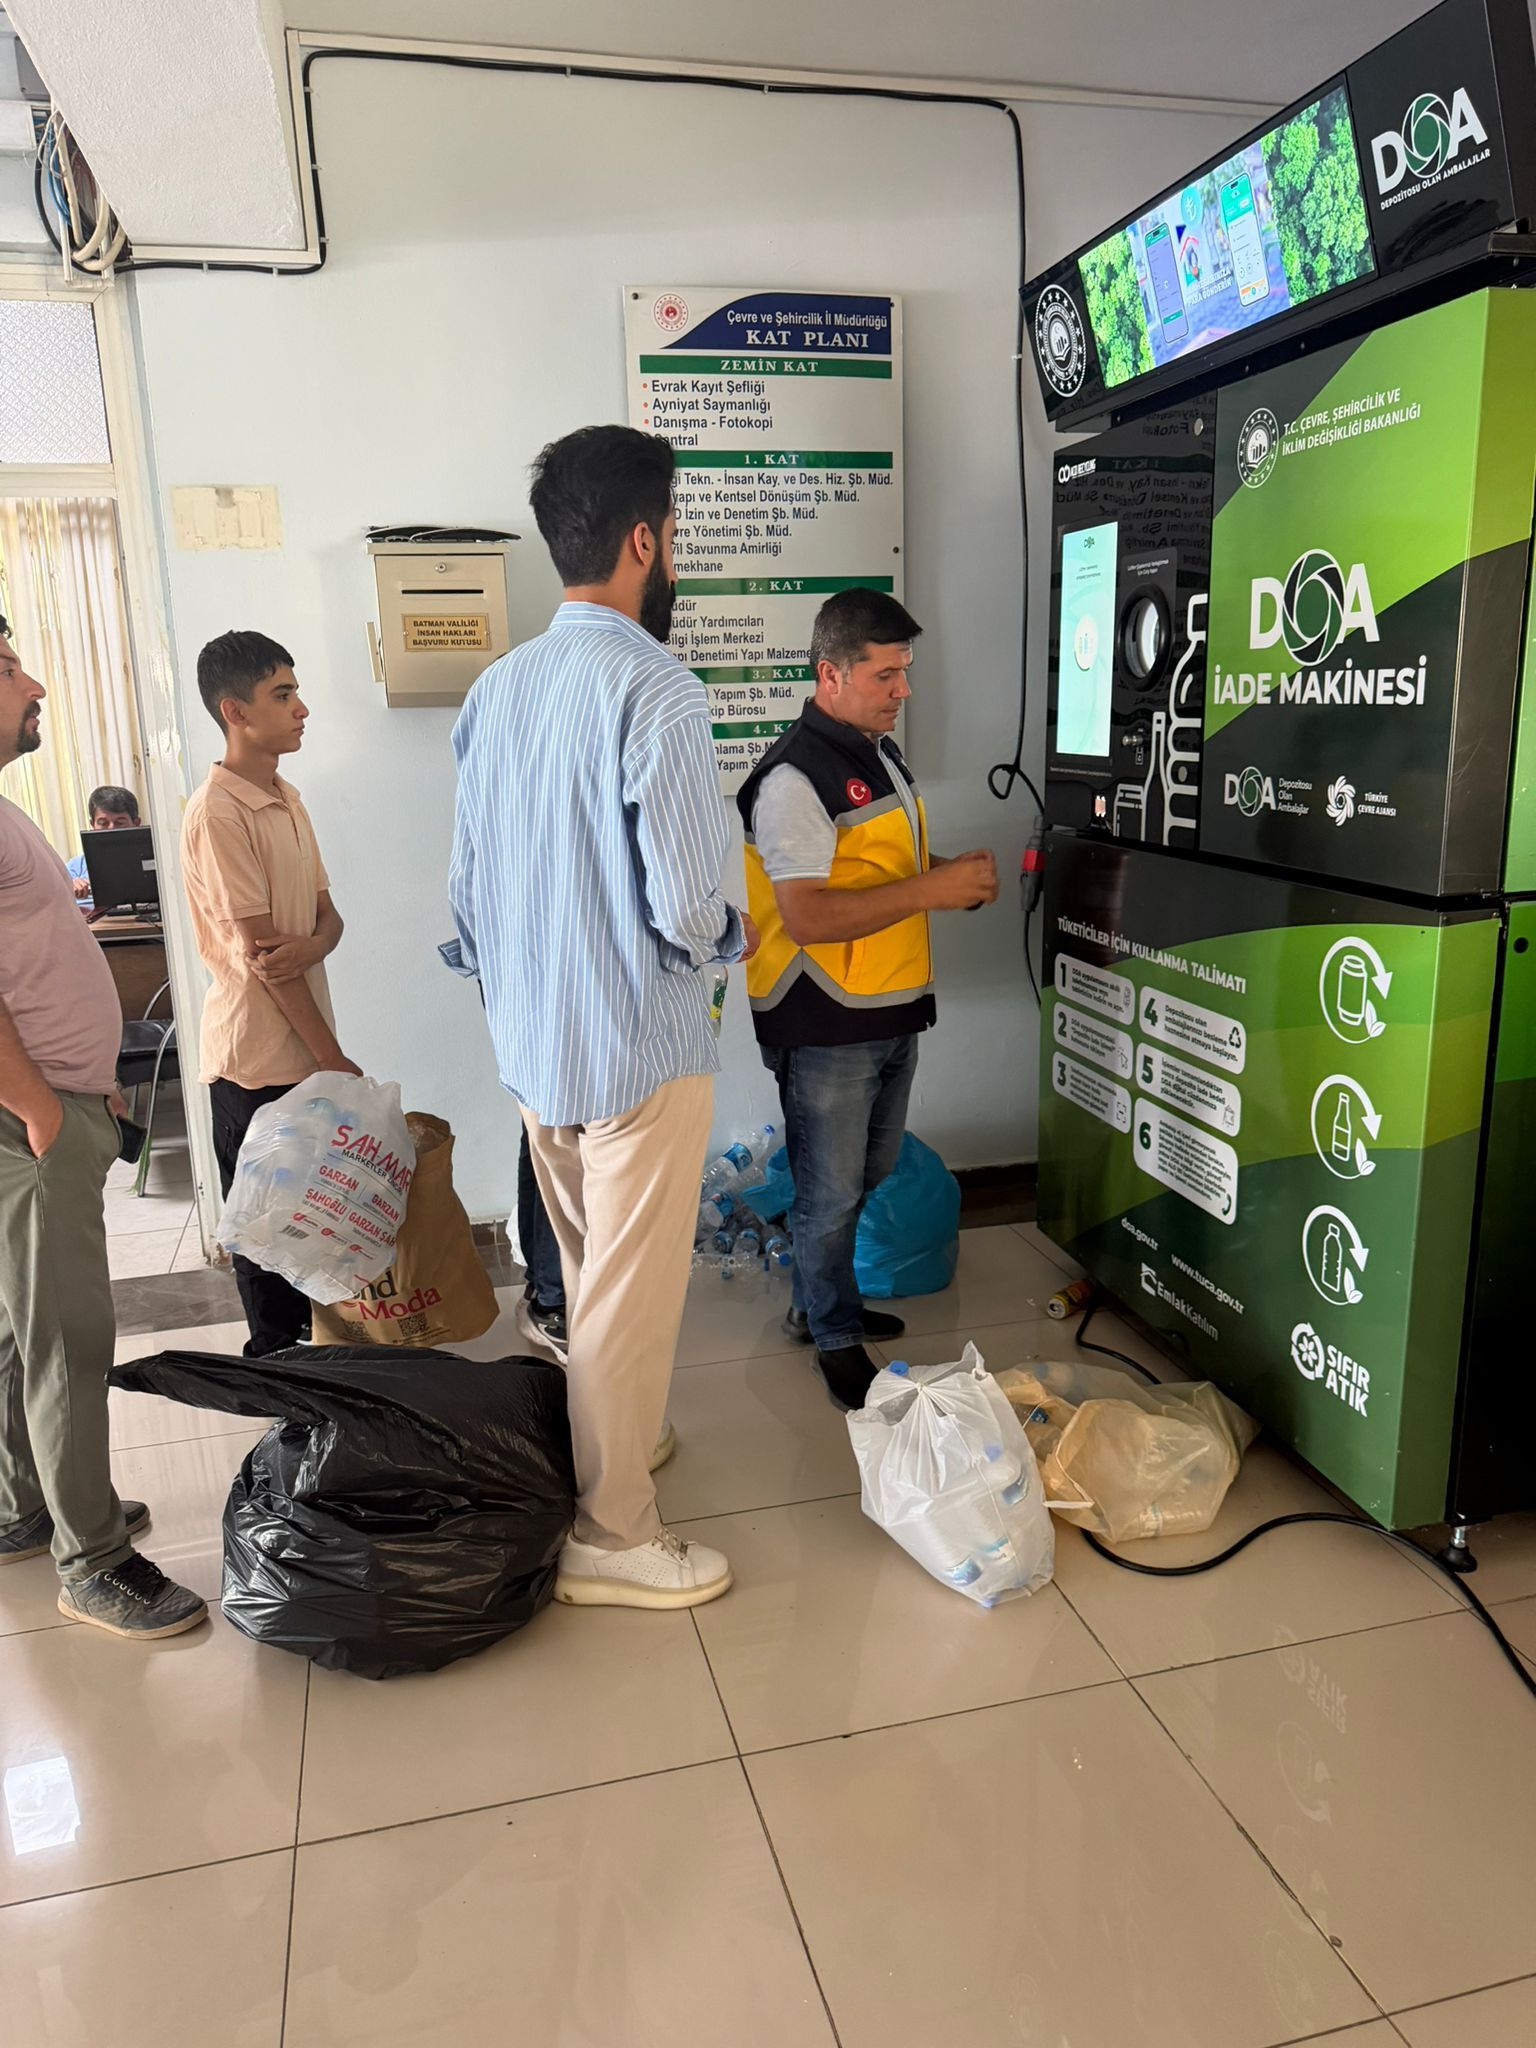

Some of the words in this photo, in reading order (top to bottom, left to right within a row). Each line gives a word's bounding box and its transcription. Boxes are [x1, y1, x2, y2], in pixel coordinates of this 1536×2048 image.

[1371, 87, 1488, 195] DOA
[1380, 184, 1421, 211] DEPOZİTOSU
[1422, 172, 1442, 189] OLAN
[1443, 148, 1491, 180] AMBALAJLAR
[727, 310, 758, 325] Çevre
[760, 313, 772, 323] ve
[776, 311, 823, 326] Şehircilik
[825, 310, 831, 325] İl
[834, 313, 887, 330] Müdürlüğü
[746, 330, 791, 345] KAT
[804, 331, 869, 347] PLANI
[720, 358, 776, 371] ZEMİN
[783, 361, 818, 372] KAT
[652, 380, 687, 392] Evrak
[691, 379, 723, 395] Kayıt
[727, 379, 765, 396] Şefliği
[652, 398, 699, 413] Ayniyat
[703, 398, 770, 413] Saymanlığı
[1284, 421, 1299, 436] T.C.
[1300, 410, 1330, 435] ÇEVRE,
[1332, 391, 1385, 422] ŞEHİRCİLİK
[1387, 388, 1401, 405] VE
[653, 416, 707, 431] Danışma
[719, 416, 773, 431] Fotokopi
[1282, 437, 1306, 456] İKLİM
[1307, 421, 1362, 449] DEĞİŞİKLİĞİ
[1363, 402, 1421, 433] BAKANLIĞI
[745, 454, 757, 464] 1.
[764, 454, 799, 464] KAT
[684, 473, 714, 485] Tekn.
[724, 469, 754, 485] İnsan
[757, 473, 780, 488] Kay.
[783, 475, 796, 485] ve
[800, 473, 822, 485] Des.
[826, 473, 845, 485] Hiz.
[848, 472, 865, 488] Şb.
[868, 473, 893, 485] Müd.
[699, 493, 711, 502] ve
[715, 490, 756, 502] Kentsel
[760, 490, 811, 504] Dönüşüm
[814, 490, 831, 504] Şb.
[835, 490, 860, 502] Müd.
[708, 510, 720, 519] ve
[724, 507, 768, 519] Denetim
[772, 507, 789, 522] Şb.
[793, 507, 818, 519] Müd.
[693, 525, 741, 537] Yönetimi
[745, 525, 762, 539] Şb.
[766, 525, 792, 537] Müd.
[686, 543, 737, 555] Savunma
[740, 542, 782, 556] Amirliği
[674, 560, 723, 572] mekhane
[749, 581, 763, 591] 2.
[770, 580, 803, 591] KAT
[672, 600, 696, 611] üdür
[1249, 549, 1380, 666] DOA
[447, 619, 478, 627] VALİLİĞİ
[672, 617, 697, 628] üdür
[700, 615, 764, 628] Yardımcıları
[413, 639, 449, 647] BAŞVURU
[691, 631, 719, 647] İşlem
[723, 631, 764, 644] Merkezi
[691, 649, 738, 661] Denetimi
[741, 649, 763, 662] Yapı
[752, 670, 765, 679] 3.
[773, 668, 805, 678] KAT
[1213, 664, 1272, 705] İADE
[1279, 654, 1427, 705] MAKİNESİ
[713, 689, 746, 702] Yapım
[749, 688, 766, 702] Şb.
[769, 687, 794, 698] Müd.
[728, 705, 766, 716] Bürosu
[753, 725, 767, 734] 4.
[717, 760, 748, 772] Yapım
[1224, 766, 1276, 817] DOA
[1279, 778, 1313, 791] Depozitosu
[1278, 789, 1293, 801] Olan
[1365, 791, 1388, 803] TÜRKİYE
[1277, 803, 1310, 816] Ambalajlar
[1357, 804, 1375, 815] ÇEVRE
[1376, 806, 1397, 816] AJANSI
[1057, 915, 1110, 948] TÜKETİCİLER
[1110, 930, 1130, 954] İÇİN
[1132, 942, 1189, 975] KULLANMA
[1191, 961, 1247, 995] TALİMATI
[1060, 962, 1066, 988] 1
[1144, 997, 1158, 1027] 4
[1058, 1011, 1067, 1038] 2
[1057, 1061, 1066, 1087] 3
[1142, 1055, 1153, 1084] 5
[1139, 1122, 1151, 1150] 6
[341, 1149, 387, 1180] MARKETLER
[319, 1165, 360, 1191] GARZAN
[305, 1188, 348, 1216] ŞAHOĞLU
[372, 1193, 400, 1222] GARZAN
[348, 1211, 382, 1237] GARZAN
[359, 1287, 442, 1320] Moda
[1327, 1344, 1370, 1393] SIFIR
[1325, 1368, 1369, 1418] ATIK
